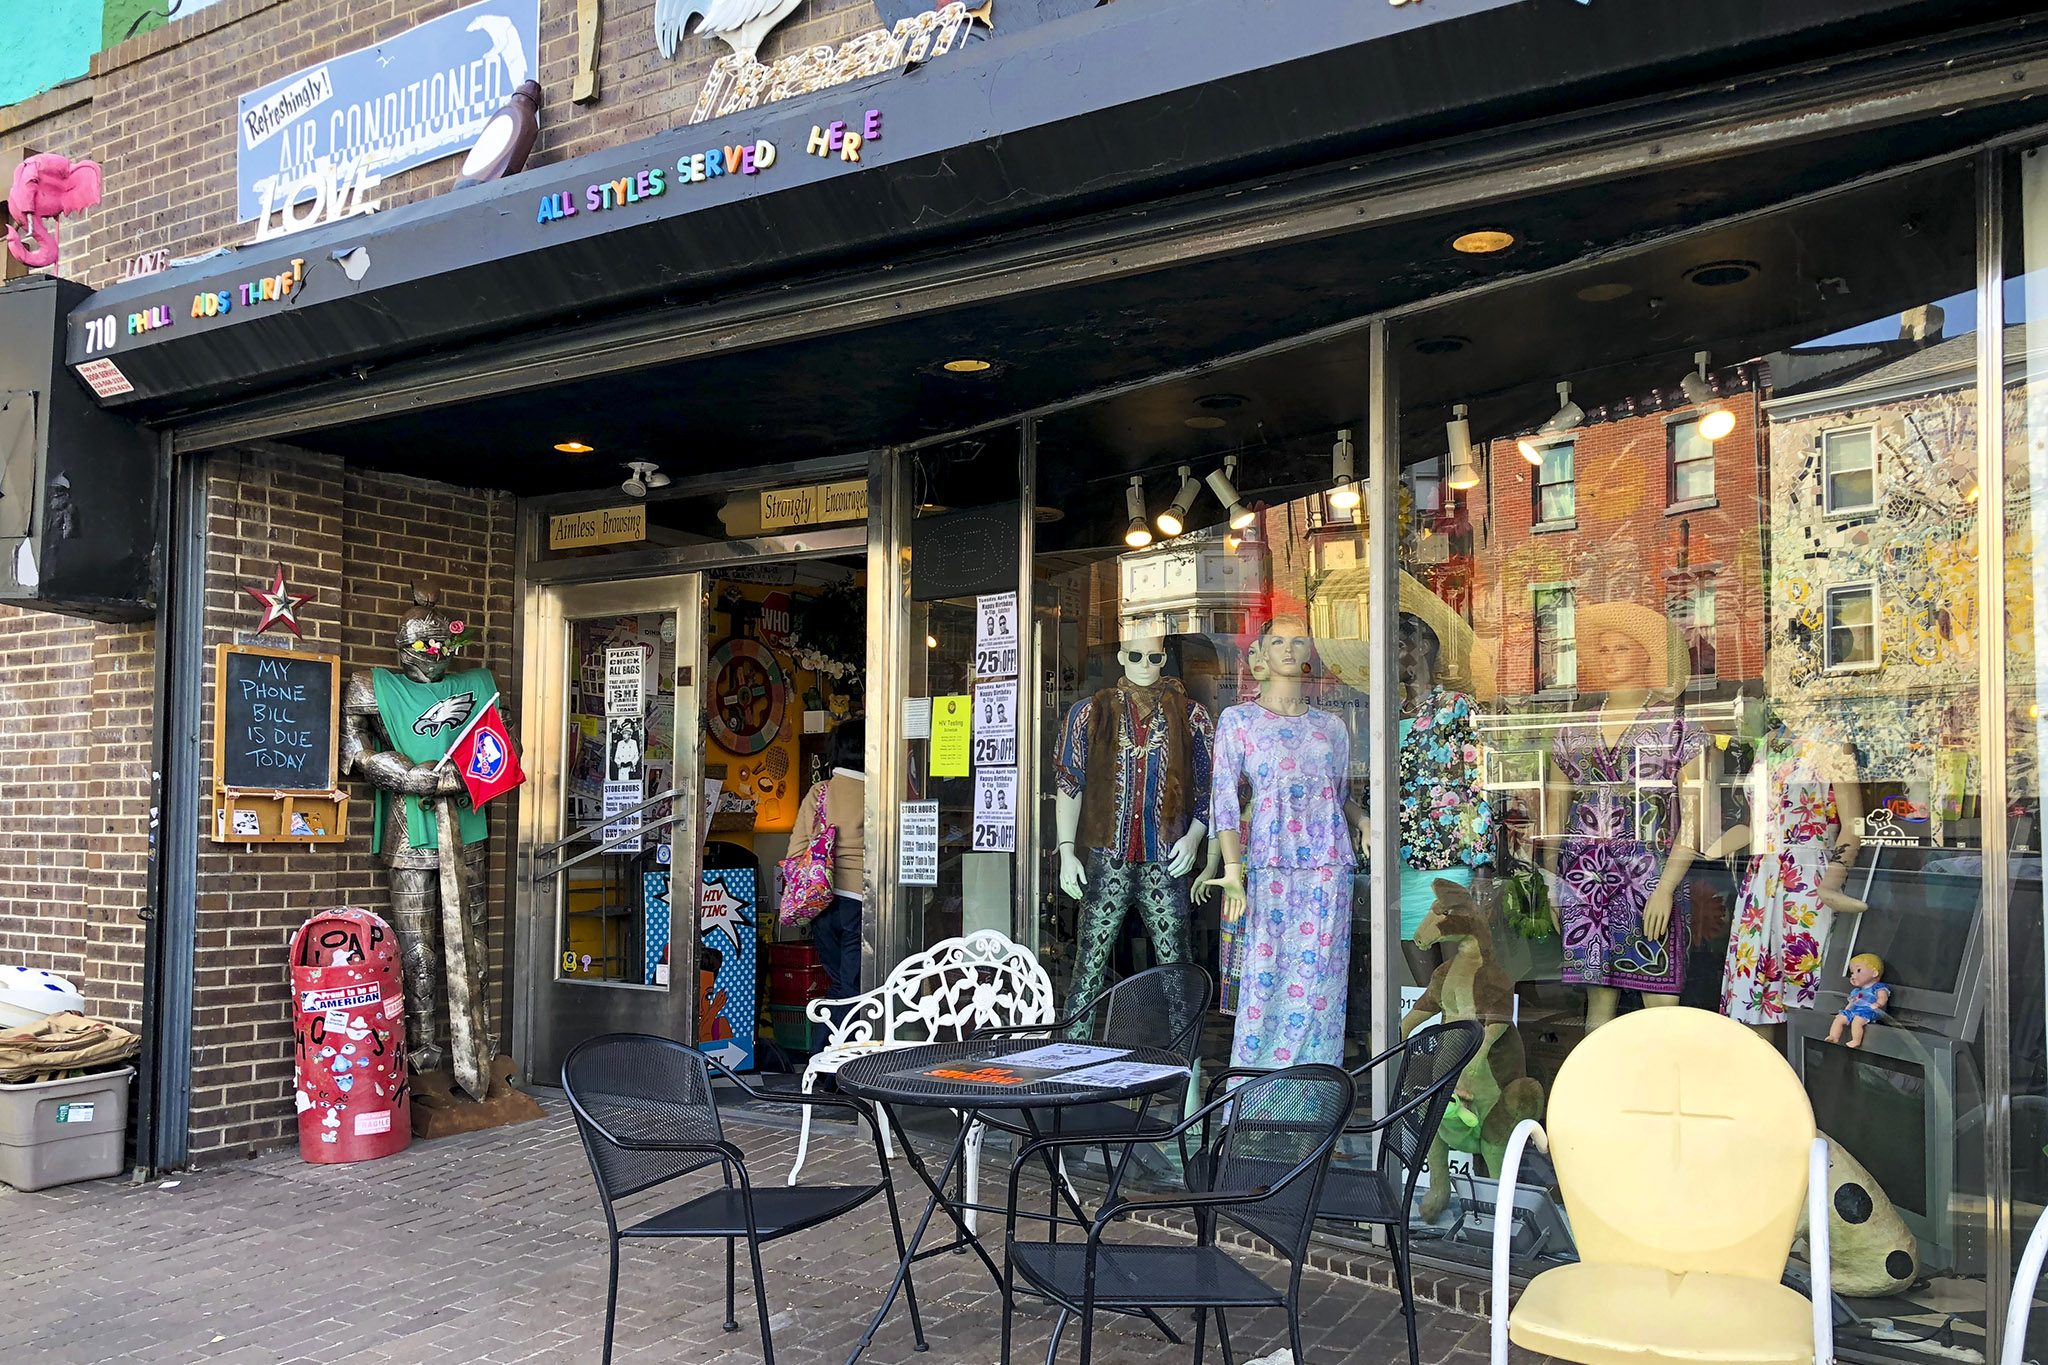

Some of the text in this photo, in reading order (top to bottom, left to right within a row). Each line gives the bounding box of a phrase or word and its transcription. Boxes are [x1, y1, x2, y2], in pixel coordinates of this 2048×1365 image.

[244, 71, 331, 142] Refreshingly!
[278, 53, 502, 184] AIR CONDITIONED
[537, 109, 882, 224] ALL STYLES SERVED HERE
[252, 150, 391, 241] LOVE
[124, 248, 171, 281] LOVE
[127, 258, 305, 336] PHILL AIDS THRIFT
[85, 314, 117, 354] 710
[765, 490, 811, 524] Strongly
[602, 509, 641, 540] Browsing
[923, 525, 1005, 577] OPEN
[761, 608, 790, 633] WHO
[258, 659, 293, 682] MY
[609, 665, 640, 676] ALL BAGS
[1002, 648, 1016, 673] OFF!
[239, 680, 306, 702] PHONE
[614, 690, 638, 699] SHE
[253, 704, 296, 724] BILL
[248, 726, 313, 748] IS DUE
[1000, 738, 1014, 760] OFF!
[245, 748, 307, 772] TODAY
[604, 784, 640, 793] STORE HOURS
[902, 805, 936, 814] STORE HOURS
[1001, 824, 1014, 848] OFF!
[703, 890, 724, 902] HIV
[701, 904, 727, 918] TING
[320, 992, 380, 1009] AMERICAN
[321, 990, 345, 1000] Proud
[347, 988, 355, 996] to
[357, 986, 366, 994] be
